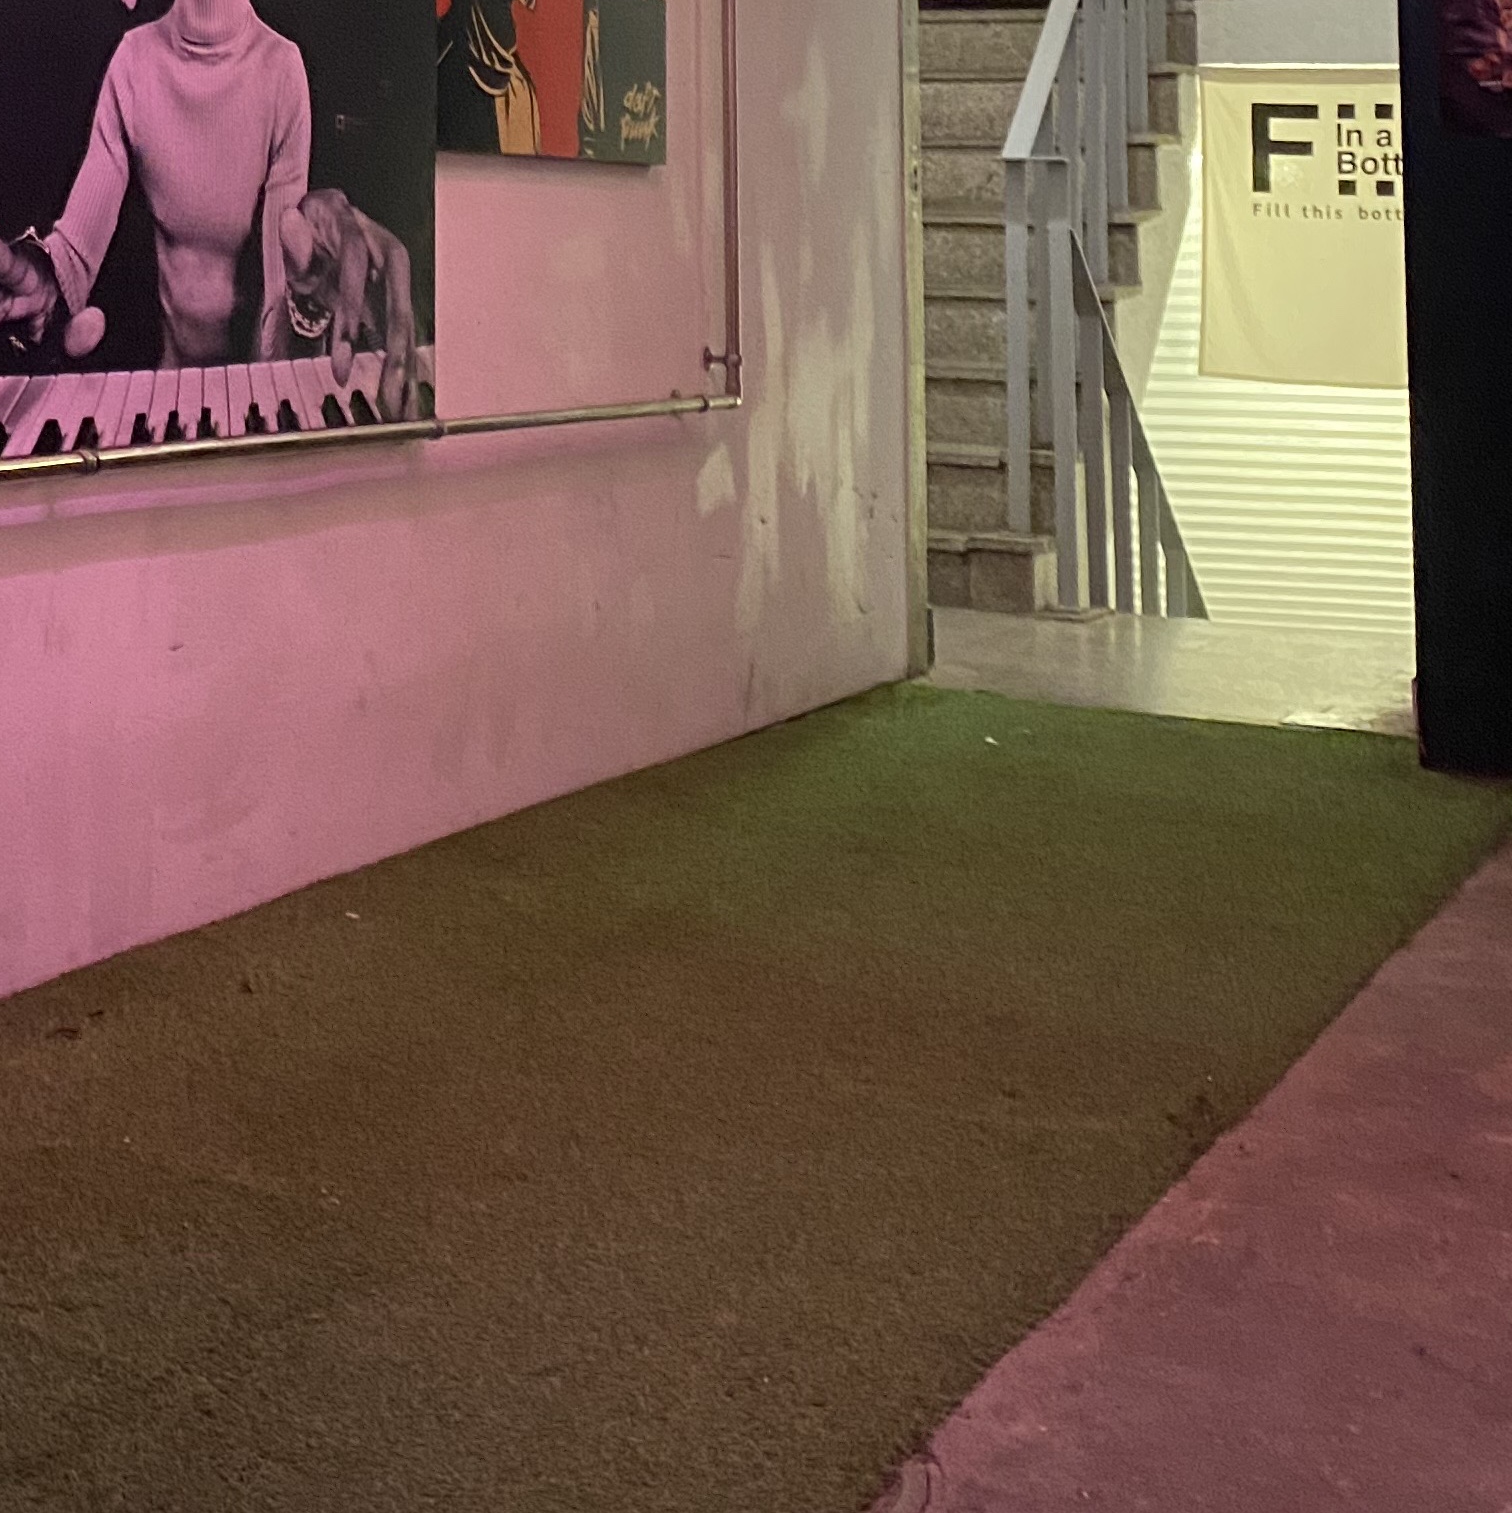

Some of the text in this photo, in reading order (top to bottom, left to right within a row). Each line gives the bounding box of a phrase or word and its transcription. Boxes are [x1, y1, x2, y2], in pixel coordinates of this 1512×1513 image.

[1336, 123, 1393, 148] In a
[1252, 203, 1291, 219] Fill
[1301, 205, 1344, 221] this
